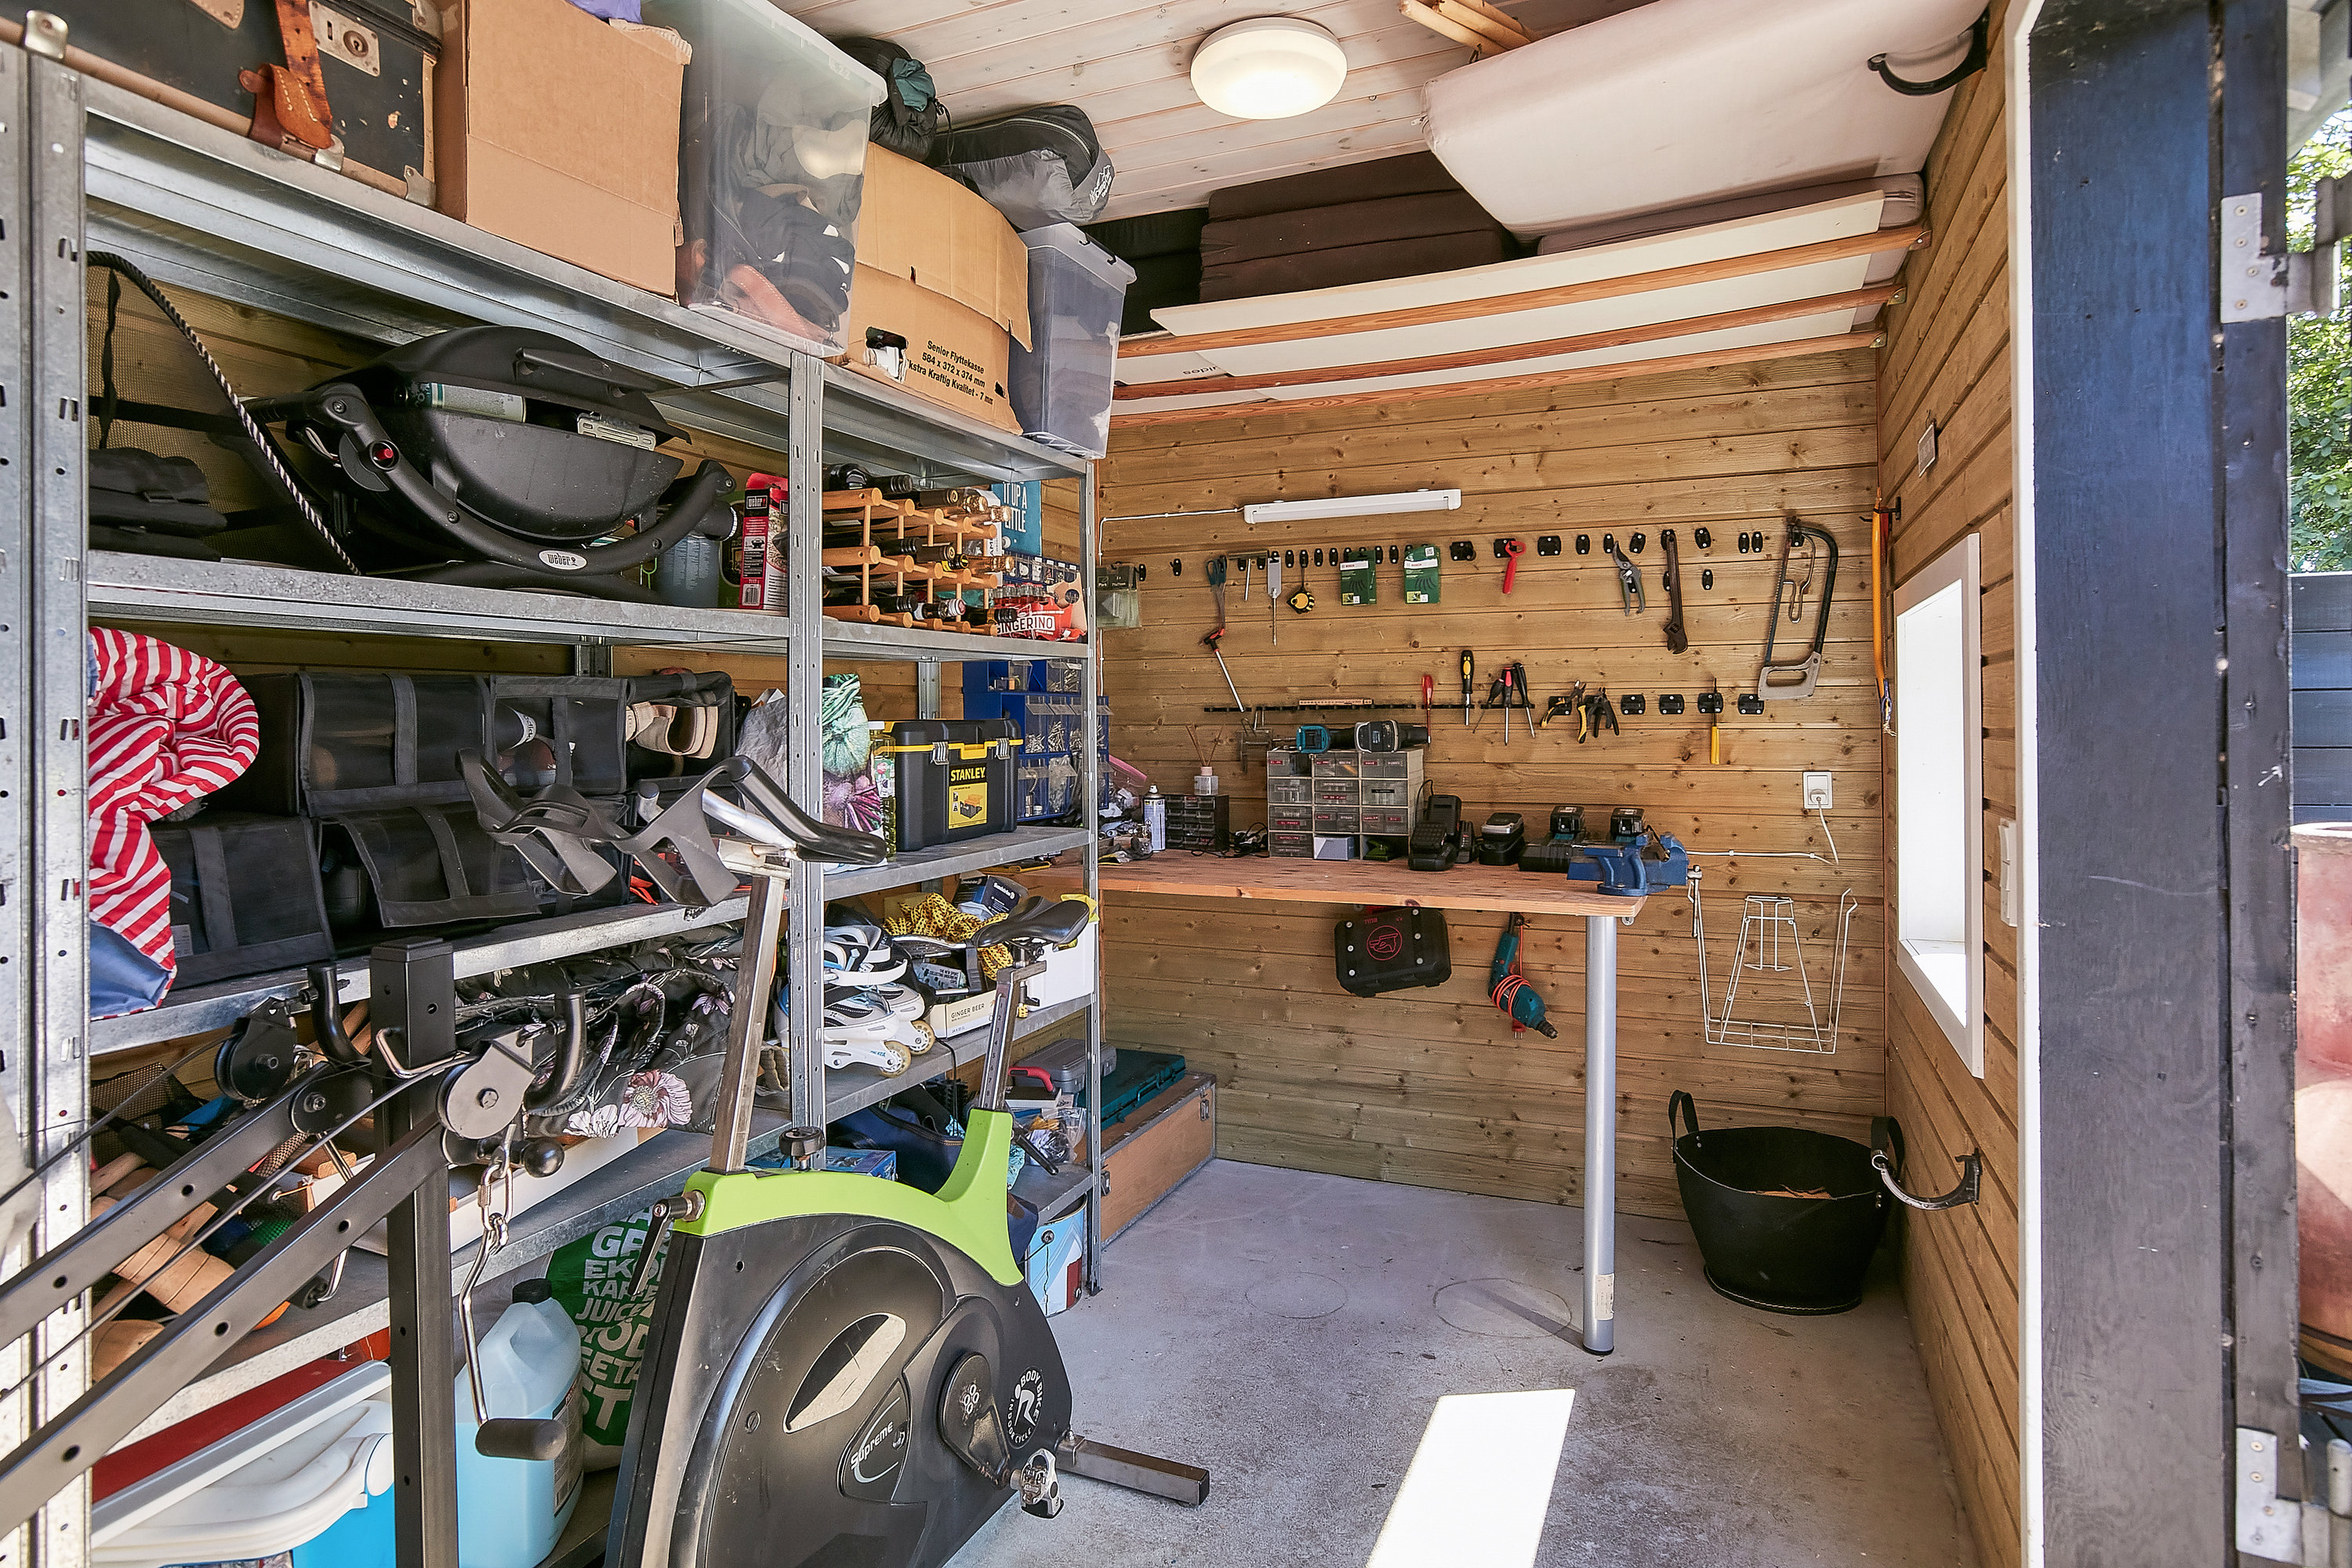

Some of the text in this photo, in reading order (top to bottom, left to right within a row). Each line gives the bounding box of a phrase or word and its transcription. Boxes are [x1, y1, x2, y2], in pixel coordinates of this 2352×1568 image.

[921, 352, 936, 365] 584
[942, 359, 955, 374] 372
[961, 368, 974, 382] 374
[974, 376, 985, 388] mm
[927, 339, 985, 374] Senior Flyttekasse
[907, 358, 927, 376] kstra
[927, 367, 951, 387] Kraftig
[951, 379, 975, 397] Kvalitet
[979, 391, 985, 401] 7
[1011, 482, 1021, 507] UP
[1022, 486, 1028, 510] A
[547, 553, 571, 566] weber
[950, 767, 985, 782] STANLEY
[950, 1003, 985, 1019] GINGER BEER
[1020, 1370, 1043, 1418] BODY BIKE
[1007, 1399, 1033, 1443] INDOOR CYCLE
[850, 1421, 894, 1471] Supreme
